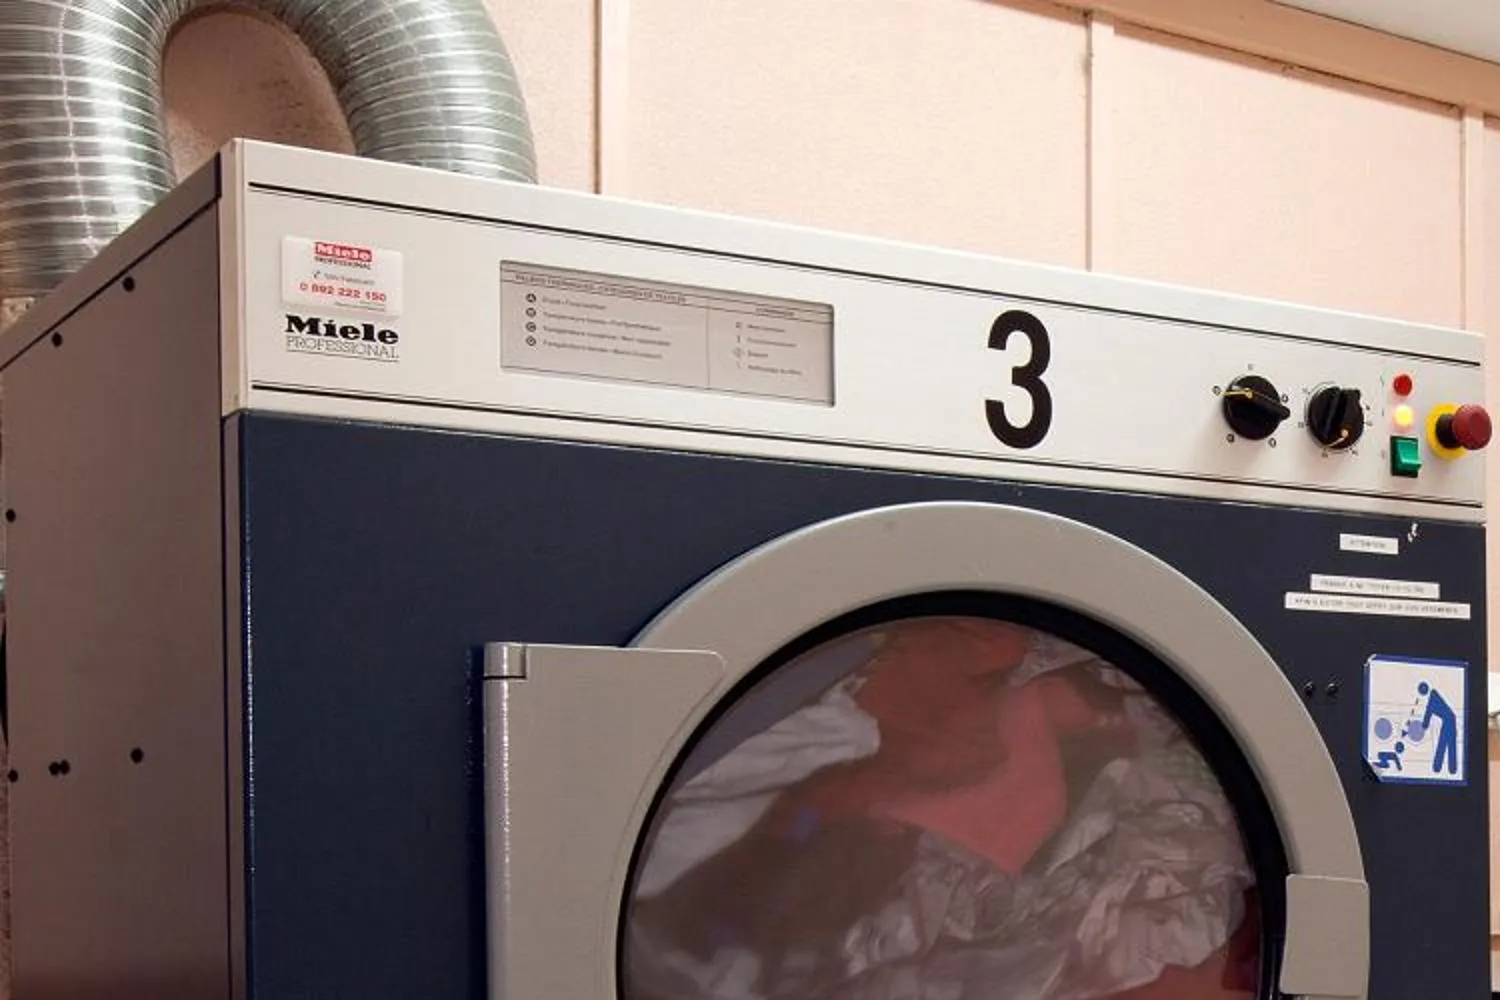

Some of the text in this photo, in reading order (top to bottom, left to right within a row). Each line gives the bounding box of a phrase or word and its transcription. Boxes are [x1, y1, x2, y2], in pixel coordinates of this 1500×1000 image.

[316, 243, 372, 262] Miele
[312, 283, 334, 295] 892
[338, 287, 361, 299] 222
[365, 290, 387, 303] 150
[285, 314, 399, 345] Miele
[286, 335, 400, 359] PROFESSIONAL
[984, 309, 1053, 449] 3
